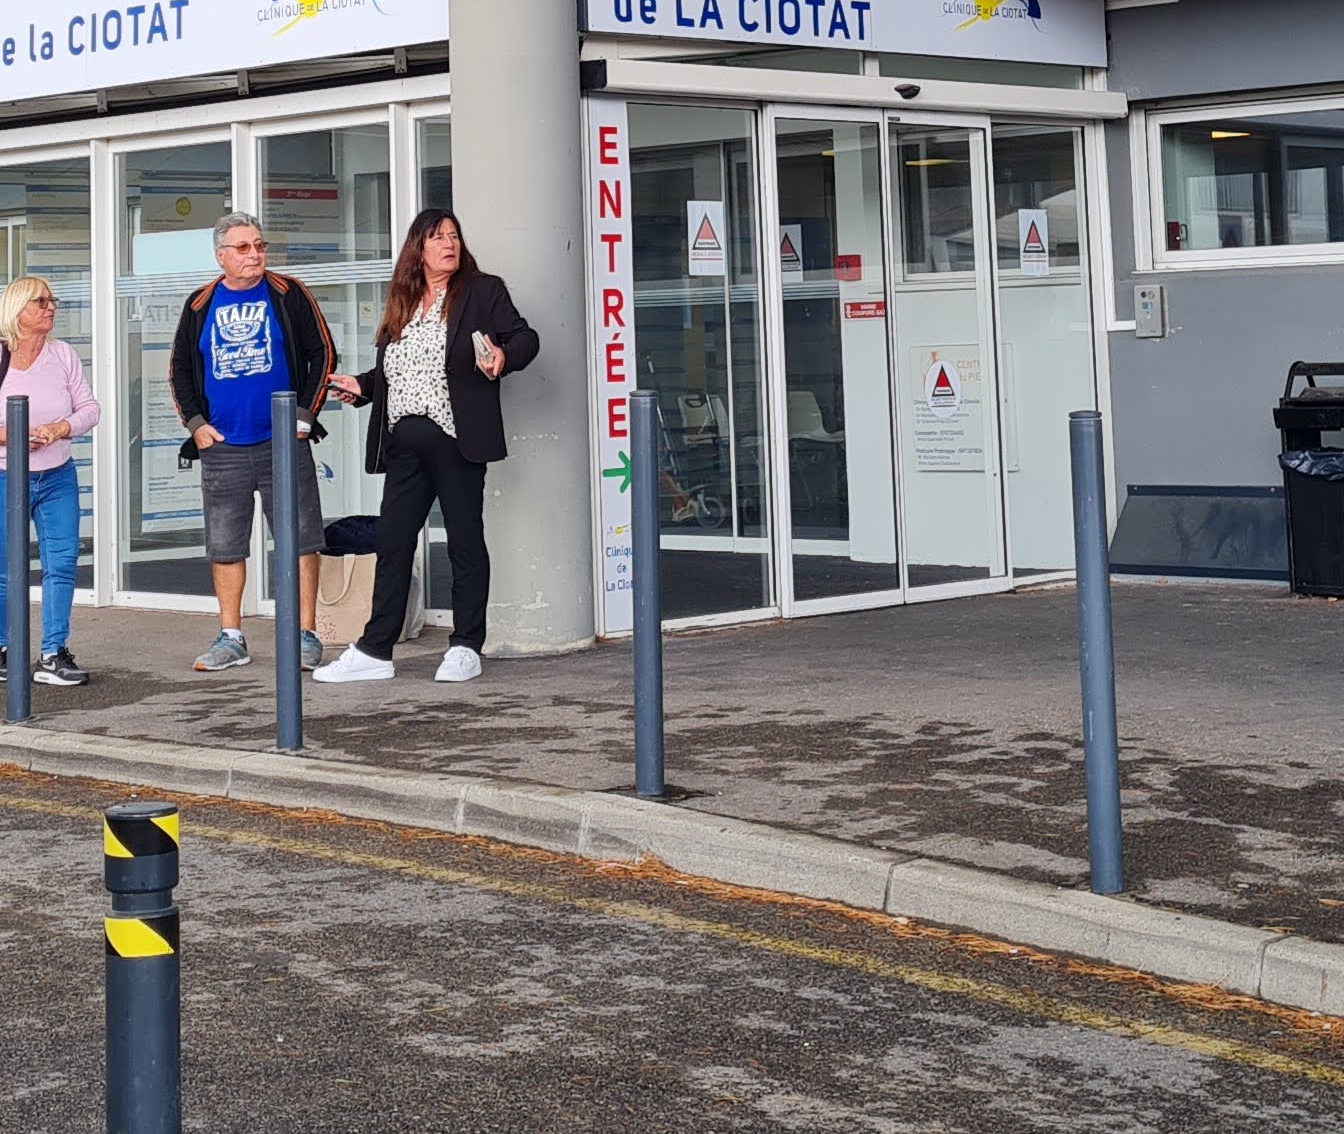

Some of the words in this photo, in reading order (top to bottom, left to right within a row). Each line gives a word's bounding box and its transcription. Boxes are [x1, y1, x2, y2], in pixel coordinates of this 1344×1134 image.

[257, 2, 305, 22] CLINIQUE
[317, 0, 328, 12] LA
[943, 2, 982, 16] CLINIQUE
[990, 7, 999, 17] LA
[1002, 7, 1027, 20] CIOTAT
[30, 24, 53, 62] la
[599, 126, 628, 438] ENTRÉE
[216, 306, 264, 327] ITALIA
[957, 360, 980, 370] CENT
